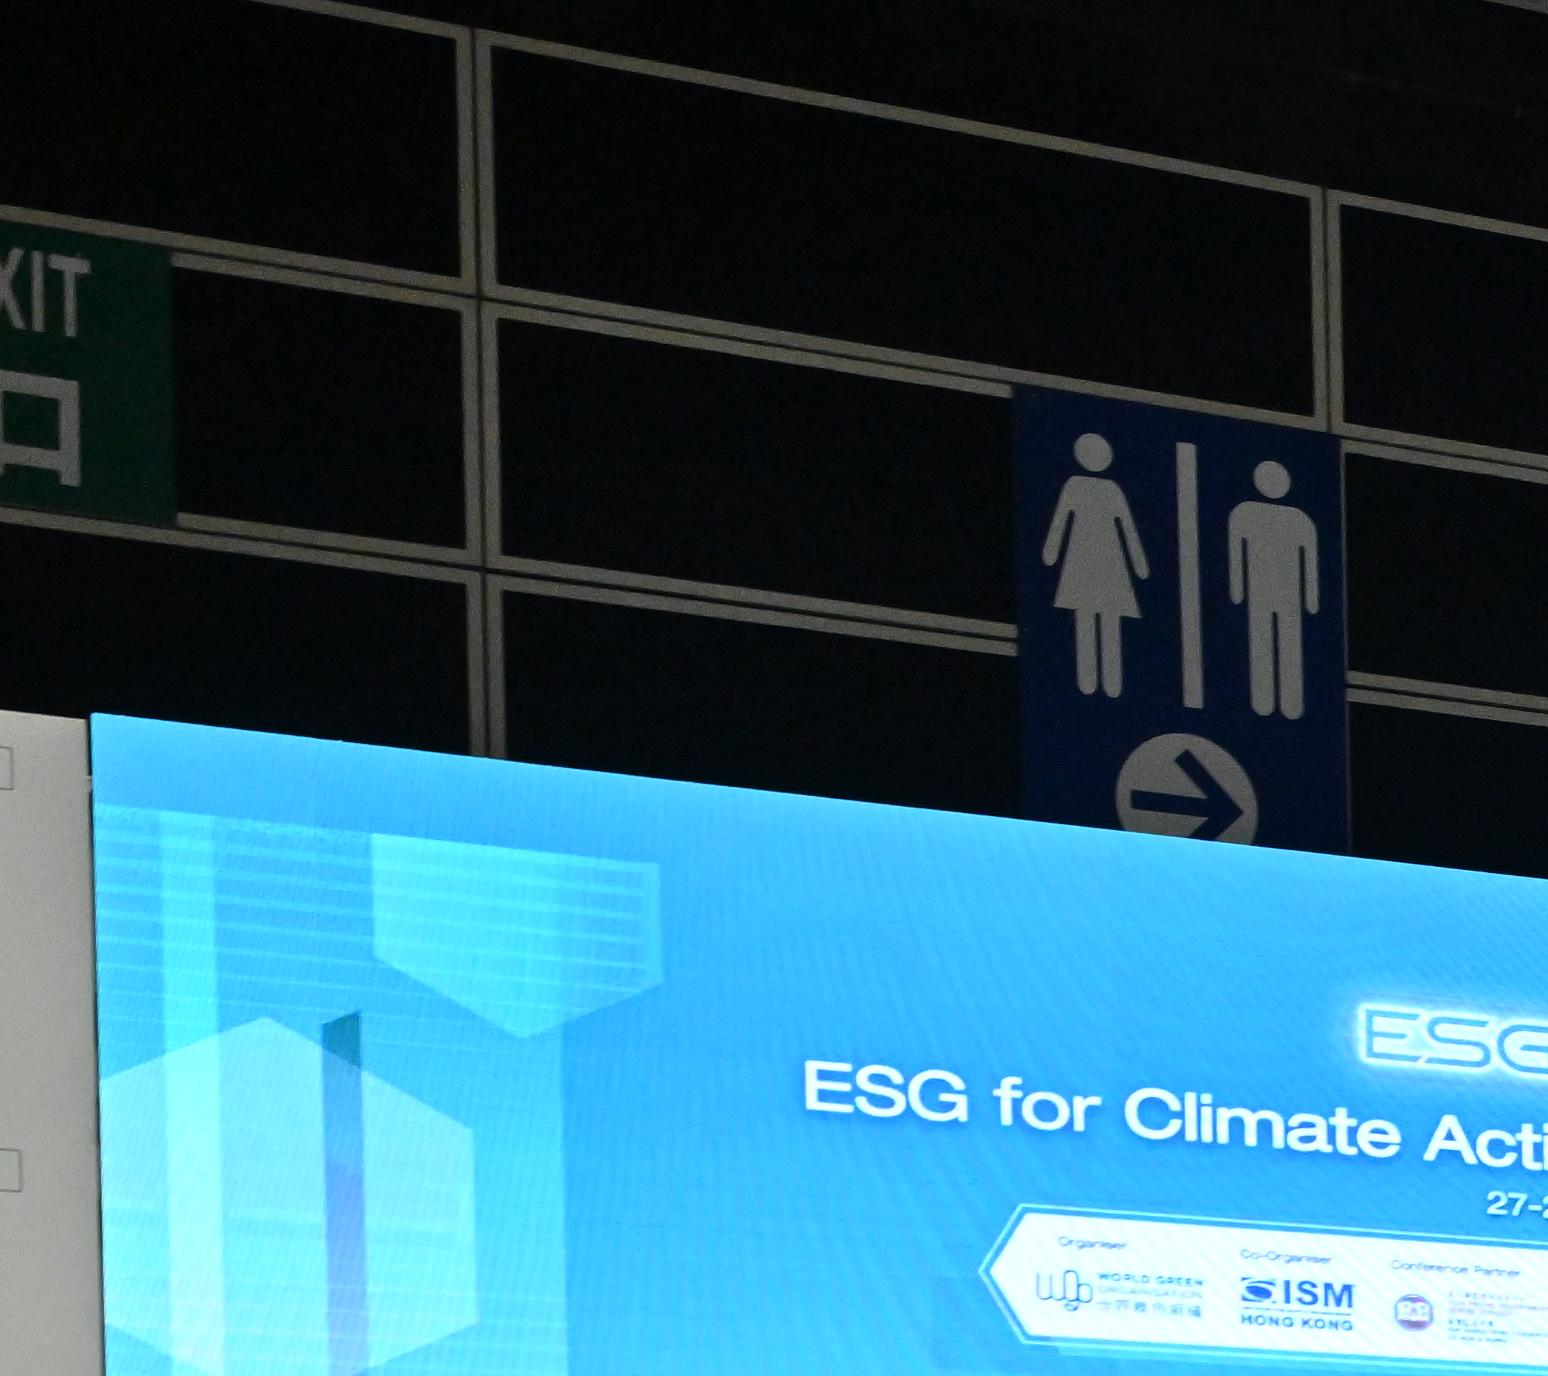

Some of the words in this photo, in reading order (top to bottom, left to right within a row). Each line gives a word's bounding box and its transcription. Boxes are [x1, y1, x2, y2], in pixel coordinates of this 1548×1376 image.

[804, 1059, 969, 1123] ESG
[991, 1076, 1102, 1134] for
[1123, 1086, 1402, 1161] Climate
[1283, 1279, 1356, 1309] ISM
[1240, 1313, 1295, 1328] HONG
[1300, 1315, 1355, 1332] KONG
